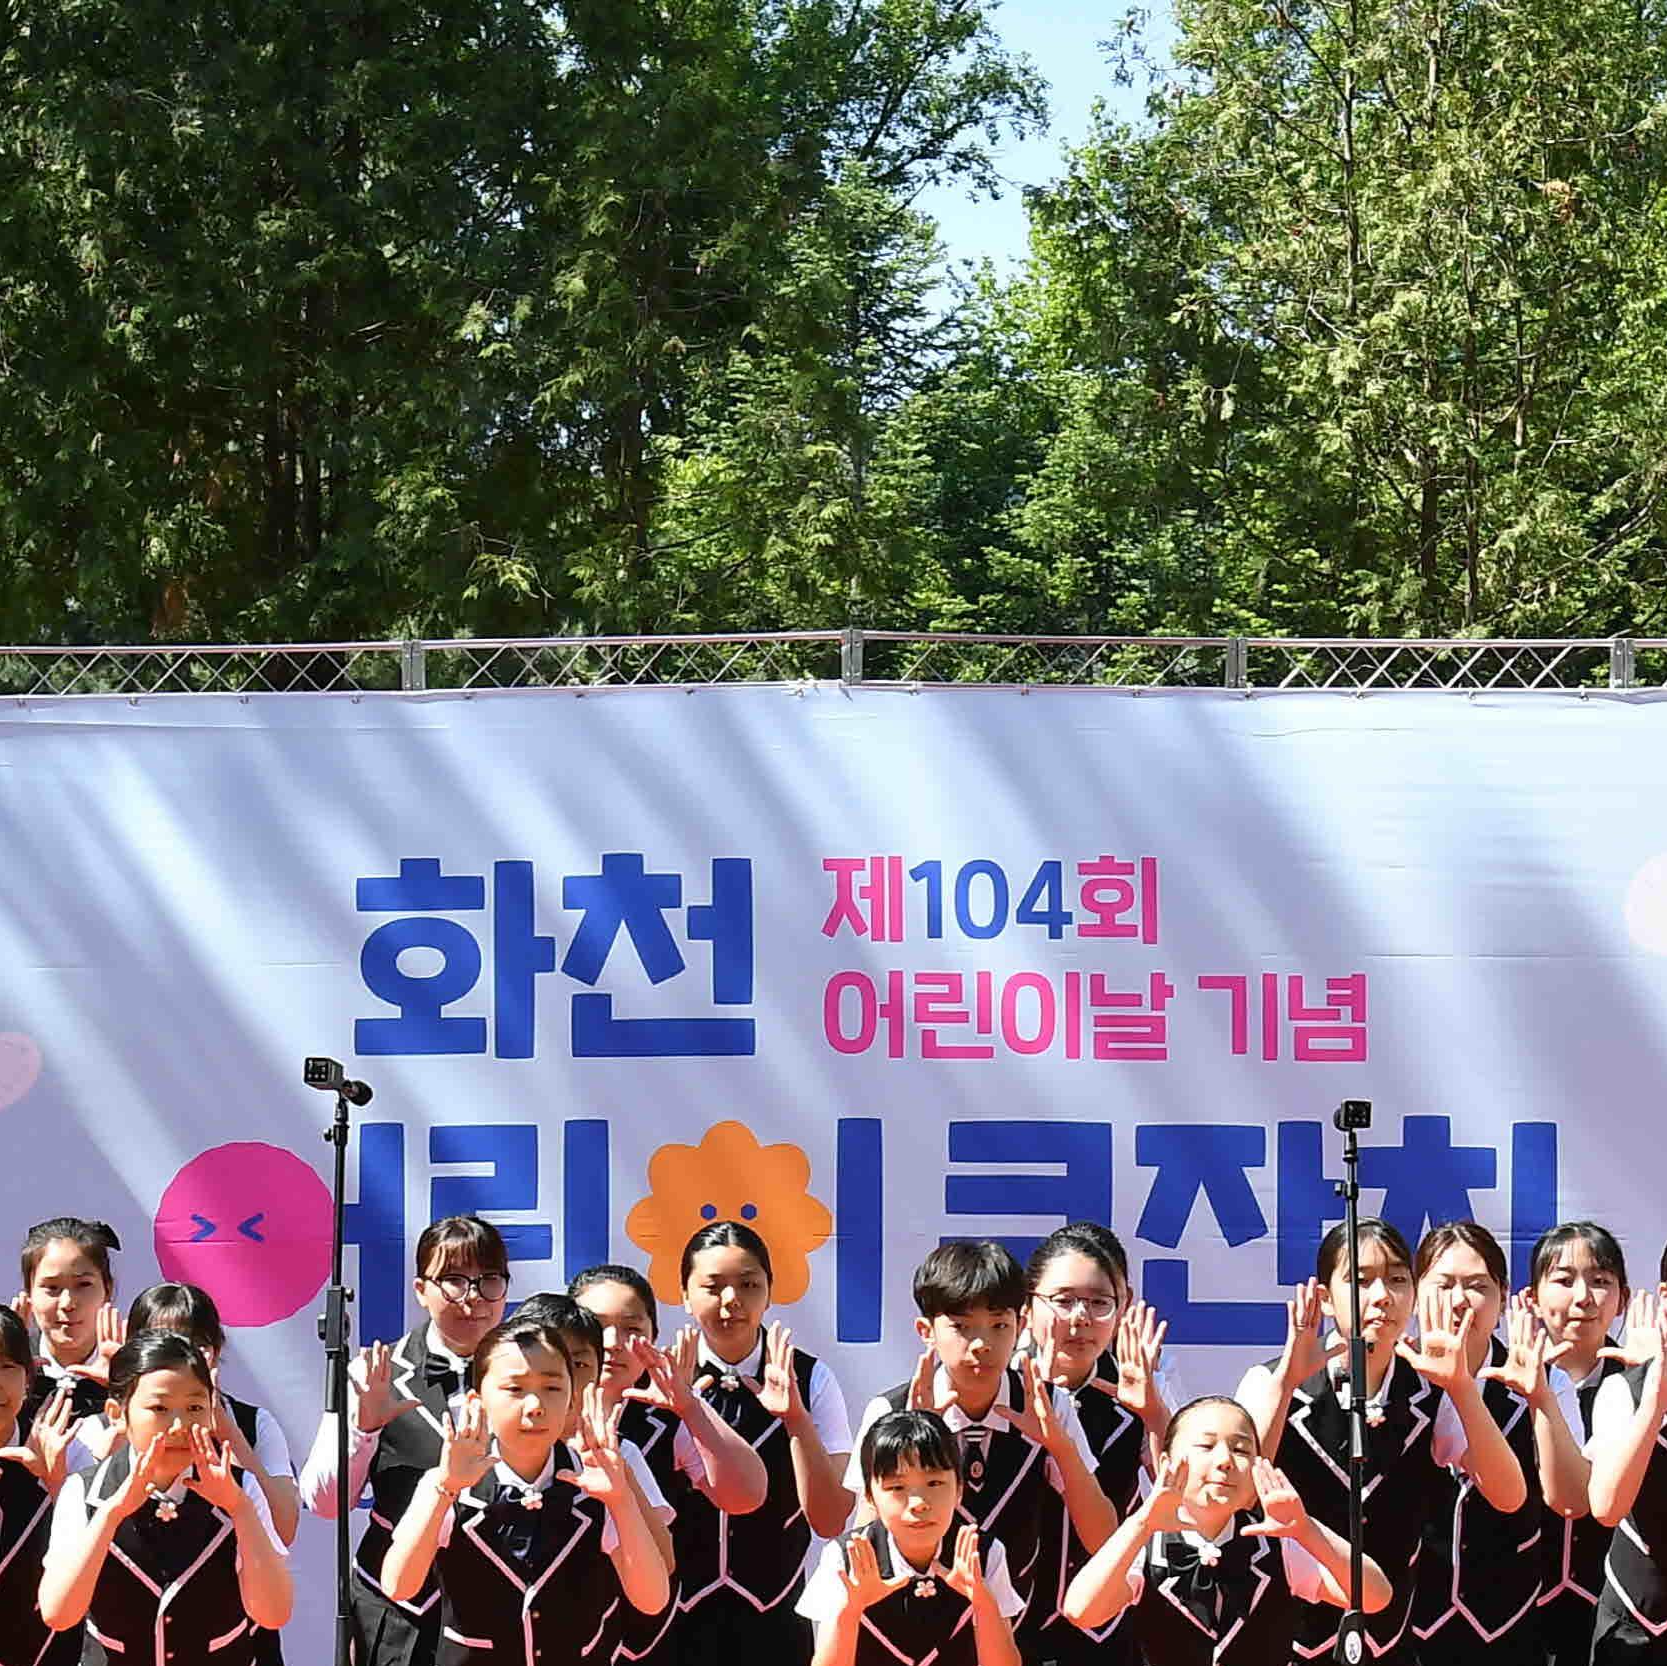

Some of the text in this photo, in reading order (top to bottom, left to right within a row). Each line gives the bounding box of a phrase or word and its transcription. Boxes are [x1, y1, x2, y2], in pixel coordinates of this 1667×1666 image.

[822, 855, 1159, 945] 제104회
[354, 852, 756, 1060] 화천
[823, 971, 1368, 1063] 어린이날 기념
